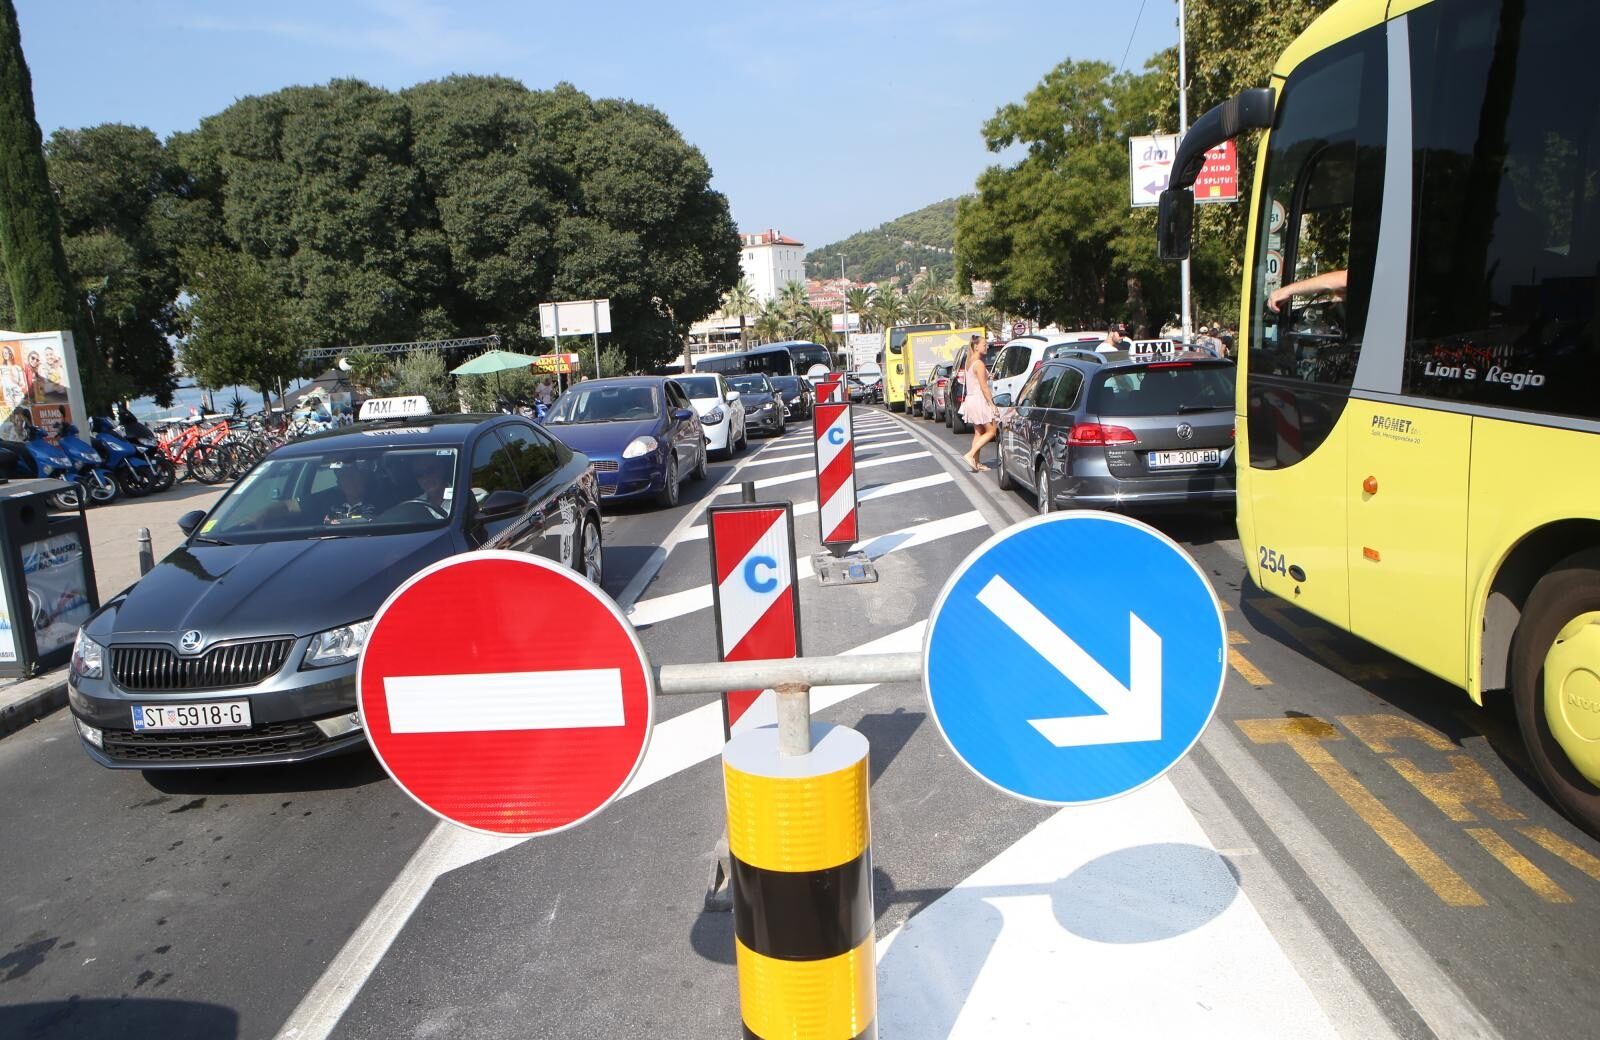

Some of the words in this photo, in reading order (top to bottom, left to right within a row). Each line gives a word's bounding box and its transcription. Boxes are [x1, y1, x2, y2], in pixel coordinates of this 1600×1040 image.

[1143, 146, 1168, 161] dm
[1203, 152, 1226, 160] VOJE
[1210, 164, 1231, 172] KINO
[1196, 177, 1202, 185] U
[1203, 176, 1233, 185] SPLITU!
[1137, 341, 1170, 353] TAXI
[1424, 361, 1477, 380] Lion's
[1485, 365, 1546, 391] Regio
[368, 400, 392, 415] TAXI
[402, 398, 417, 412] 171
[1371, 414, 1413, 434] PROMET
[828, 427, 844, 446] C
[1158, 453, 1171, 465] IM
[1259, 545, 1287, 577] 254
[744, 556, 778, 594] C
[145, 707, 164, 727] ST
[176, 704, 242, 726] 5918-G
